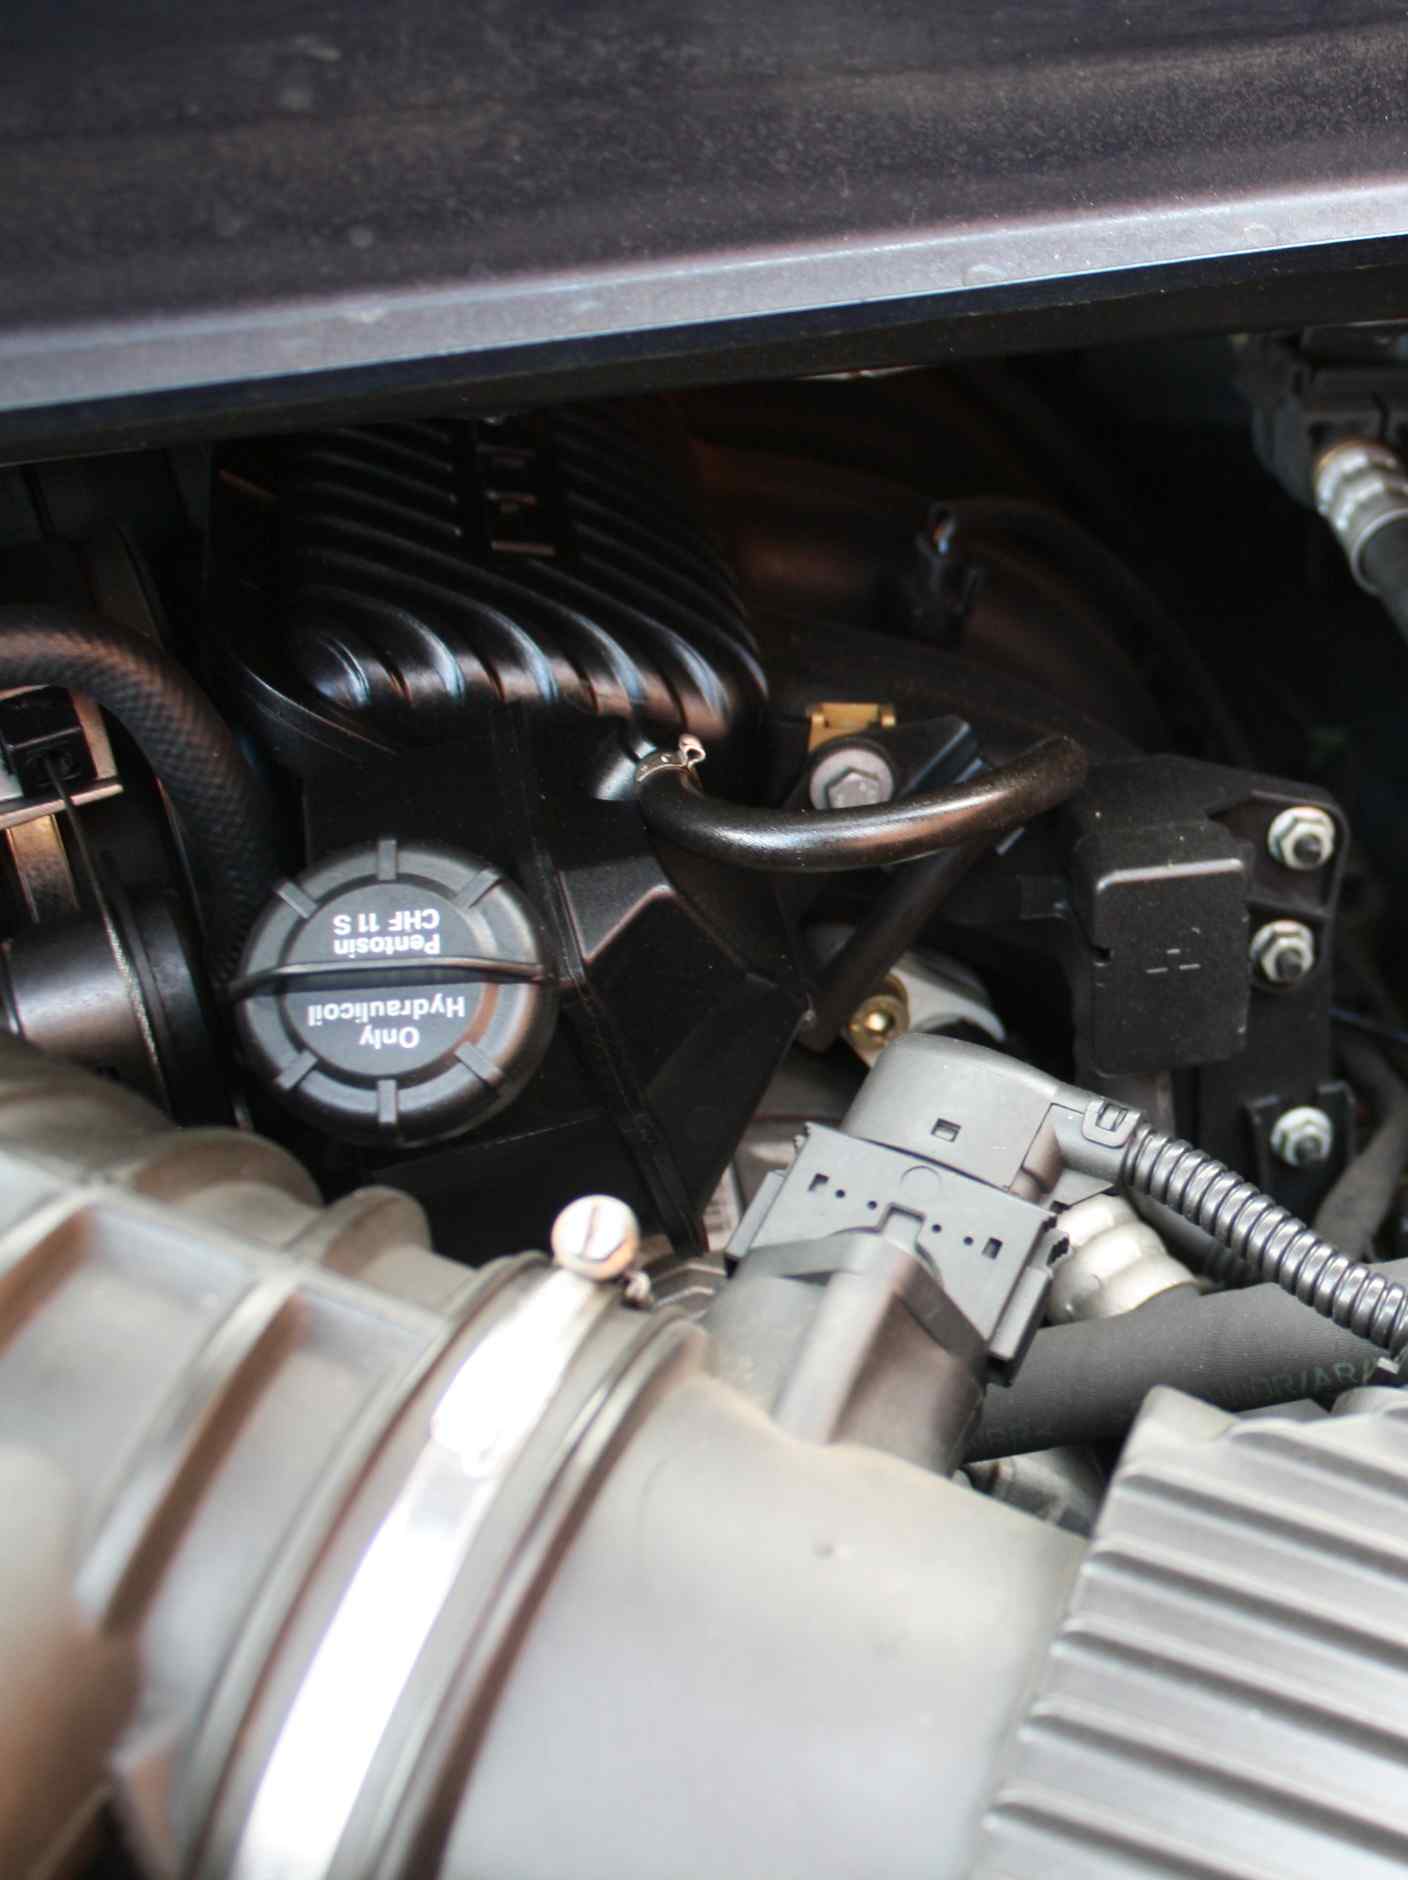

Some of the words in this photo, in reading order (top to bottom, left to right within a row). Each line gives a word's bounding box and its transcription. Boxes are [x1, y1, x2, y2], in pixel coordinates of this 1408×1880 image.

[332, 914, 352, 935] S
[359, 912, 379, 932] 11
[388, 908, 440, 931] CHF
[334, 933, 440, 958] Pentosin
[308, 993, 465, 1026] Hydraulicoil
[360, 1024, 420, 1049] Only
